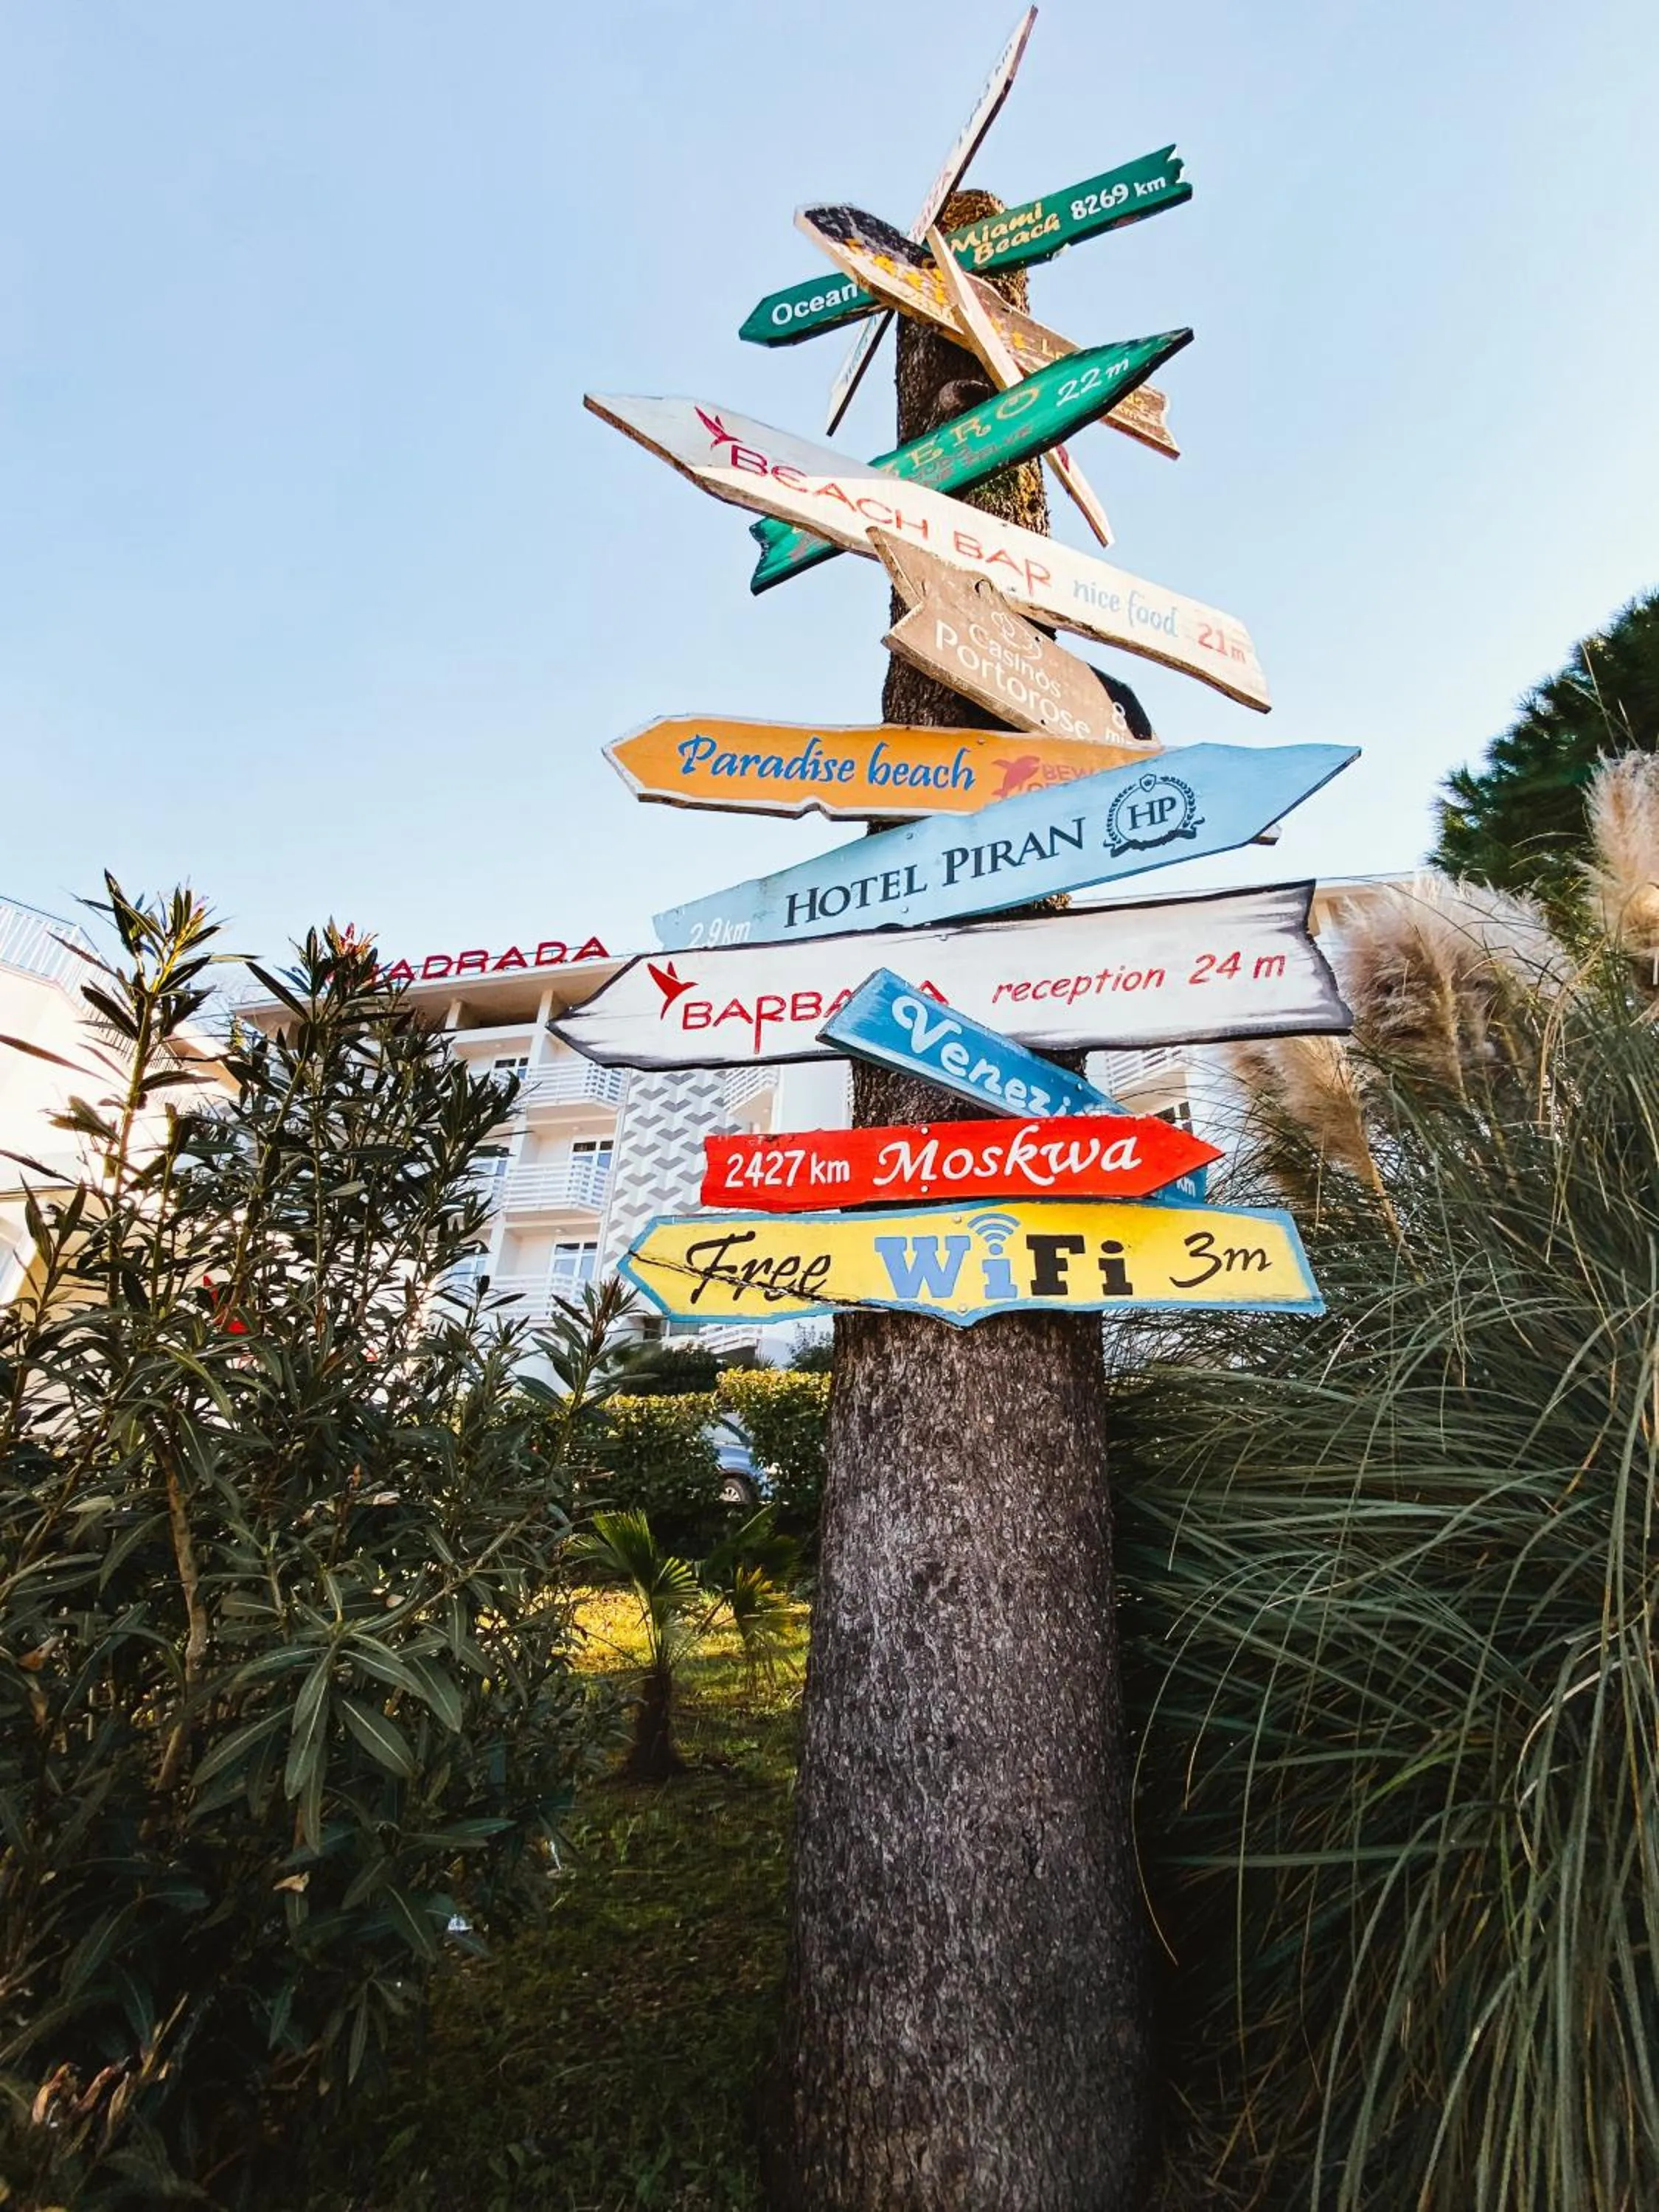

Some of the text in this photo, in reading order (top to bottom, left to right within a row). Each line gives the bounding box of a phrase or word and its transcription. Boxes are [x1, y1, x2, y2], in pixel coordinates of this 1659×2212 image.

[1071, 176, 1166, 220] 8269 km
[950, 202, 1043, 253] Miami
[973, 212, 1061, 264] Beach
[772, 282, 858, 325] Ocean
[1056, 368, 1102, 407] 22
[1106, 358, 1129, 379] m
[731, 445, 929, 540] BEACH
[953, 530, 1051, 595] BAR
[1073, 580, 1120, 612] nice
[1127, 589, 1179, 638] food
[1197, 622, 1228, 657] 21
[1231, 647, 1246, 664] m
[935, 619, 1090, 739] Portorose
[969, 624, 1060, 698] Casinos
[1112, 701, 1130, 730] 8
[678, 734, 975, 790] Paradise beach
[1127, 796, 1176, 830] HP
[784, 816, 1086, 928] HOTEL PIRAN
[992, 965, 1164, 1005] reception
[1189, 950, 1241, 985] 24
[1253, 953, 1285, 979] m
[891, 995, 1087, 1116] Venezi
[723, 1125, 1142, 1188] 2427 km Moskwa
[686, 1231, 831, 1304] Free
